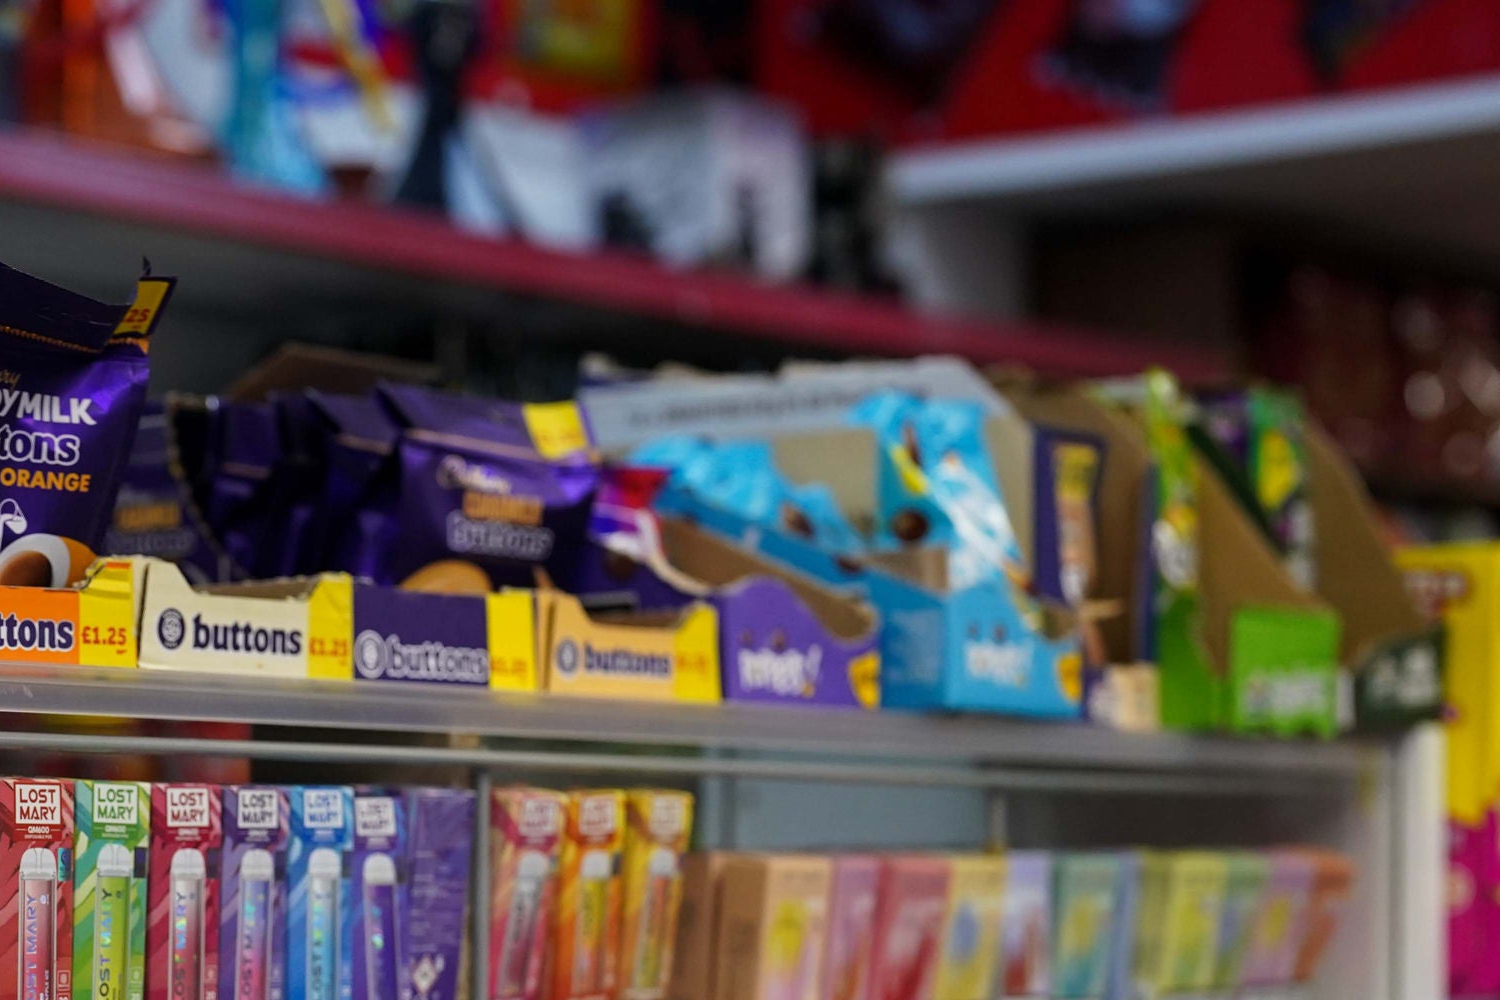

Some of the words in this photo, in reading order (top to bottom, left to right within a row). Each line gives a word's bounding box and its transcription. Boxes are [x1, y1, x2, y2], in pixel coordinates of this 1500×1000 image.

[16, 391, 98, 425] MILK
[0, 467, 92, 493] ORANGE
[82, 626, 127, 645] £1.25
[192, 612, 302, 656] buttons
[383, 633, 490, 684] buttons
[19, 788, 56, 804] LOST
[97, 788, 135, 803] LOST
[169, 791, 205, 806] LOST
[19, 805, 57, 820] MARY
[97, 805, 134, 821] MARY
